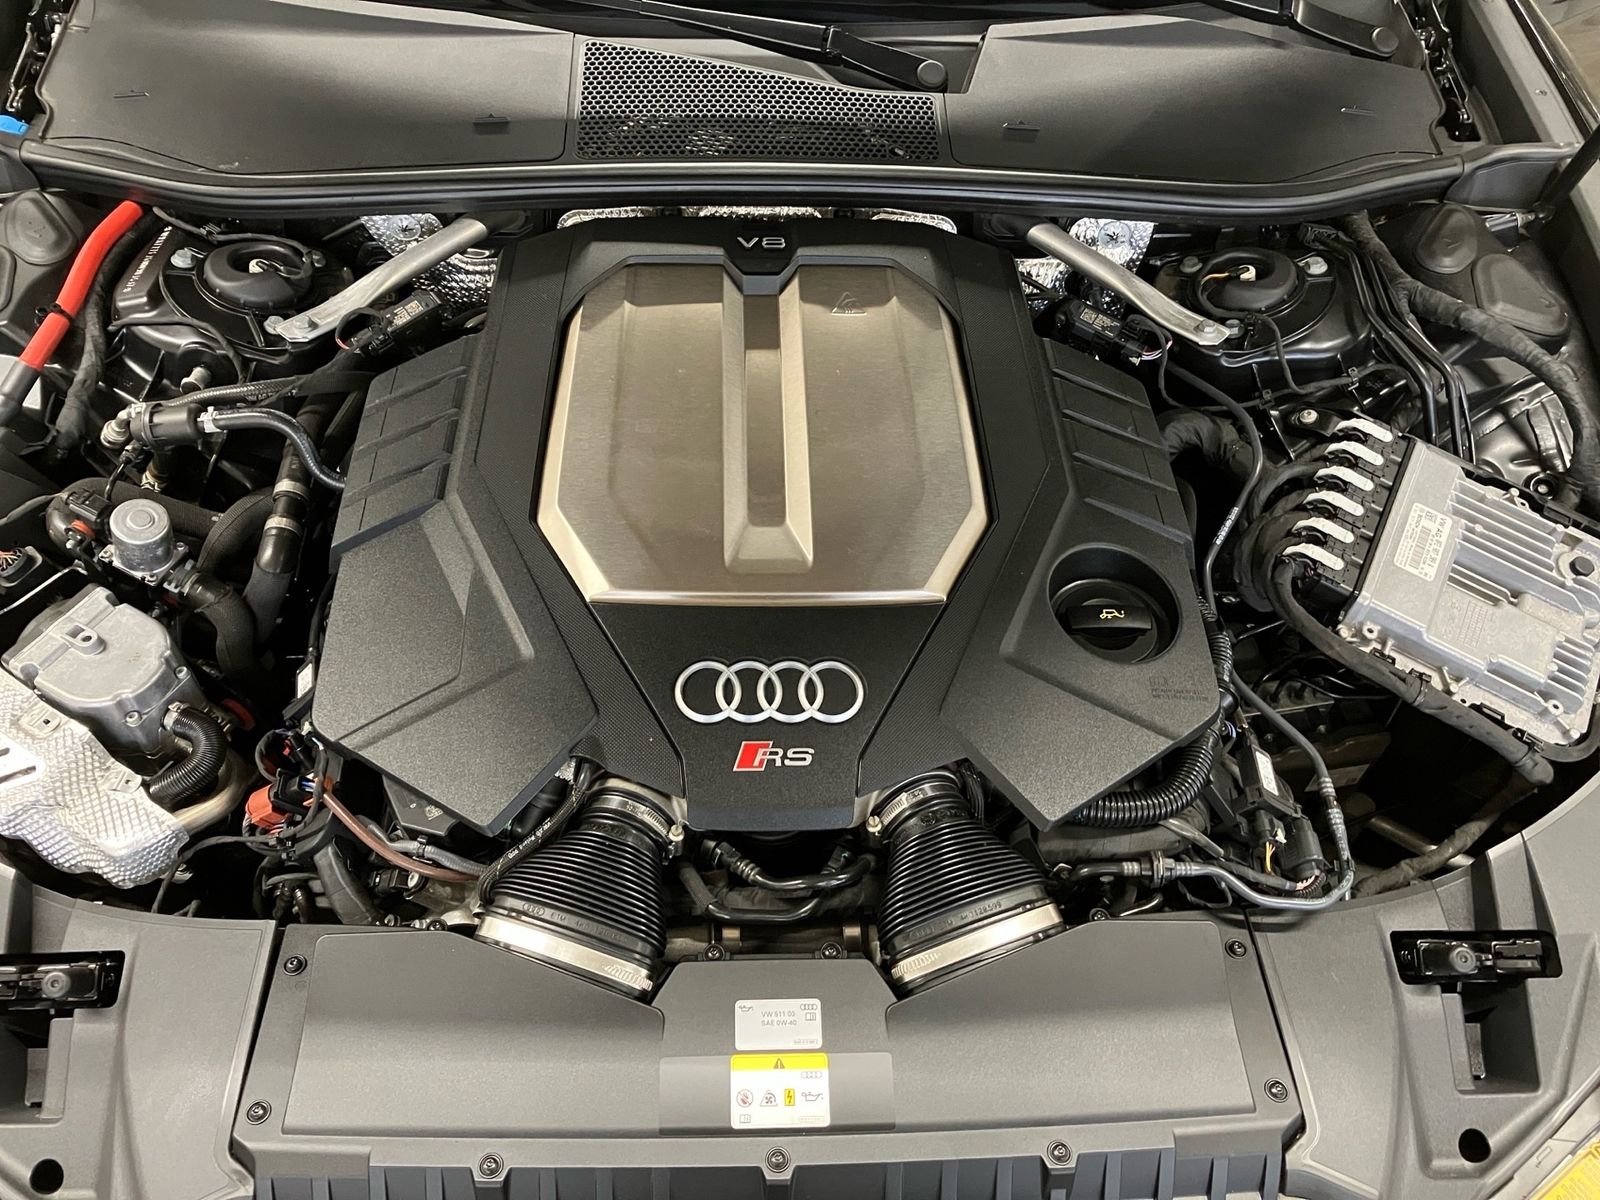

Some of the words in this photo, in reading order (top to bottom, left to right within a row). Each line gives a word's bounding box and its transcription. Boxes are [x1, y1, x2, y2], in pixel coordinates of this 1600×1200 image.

[737, 236, 786, 248] V8
[748, 745, 815, 768] RS
[760, 1010, 773, 1018] VW
[774, 1010, 786, 1018] 511
[787, 1010, 796, 1018] 00
[761, 1019, 775, 1027] SAE
[776, 1019, 798, 1027] 0W-40
